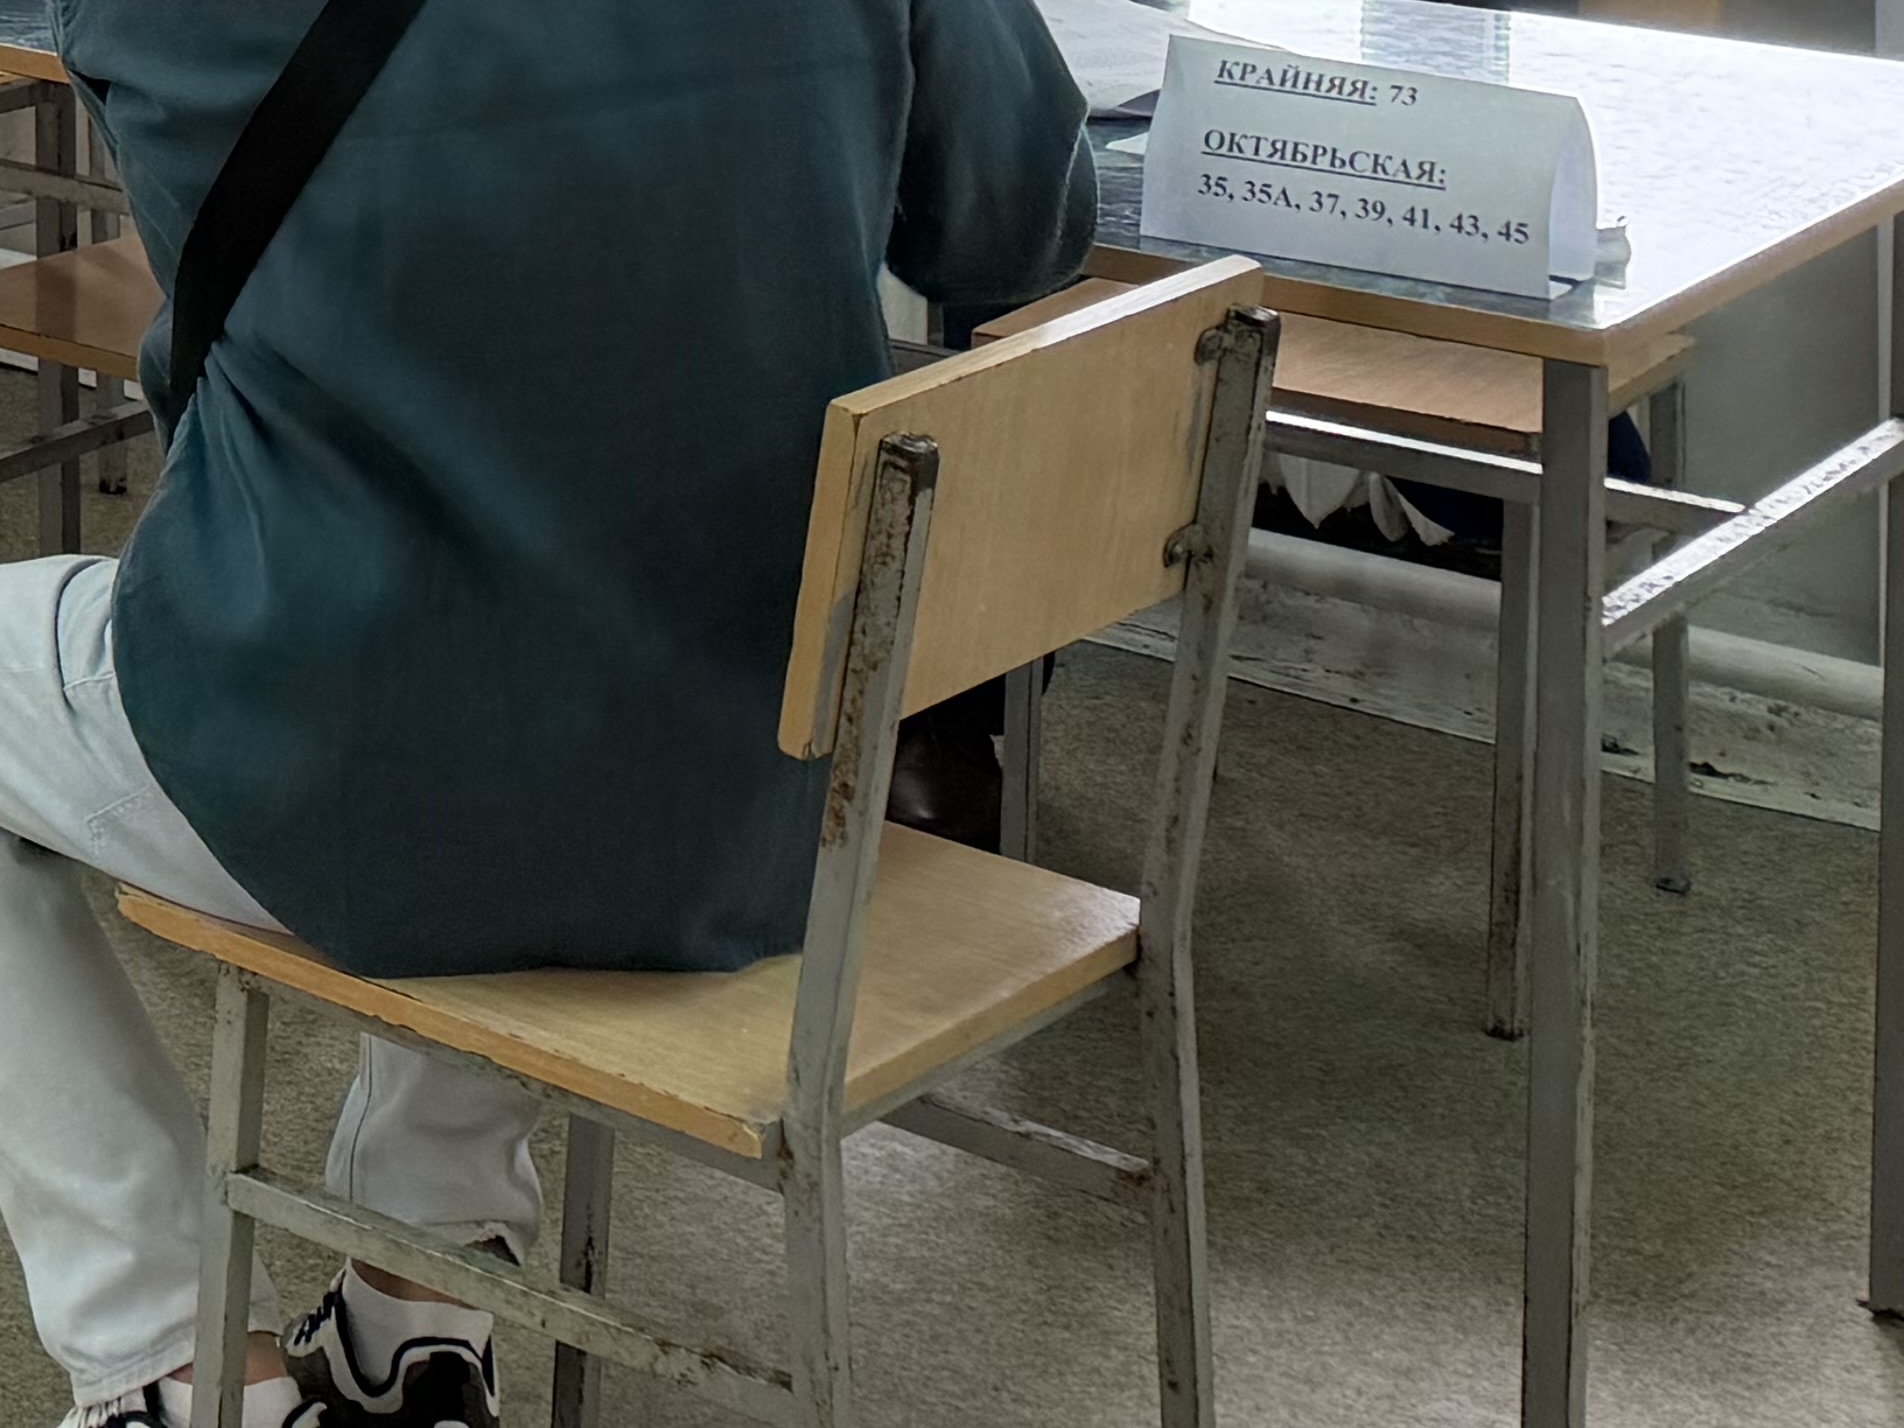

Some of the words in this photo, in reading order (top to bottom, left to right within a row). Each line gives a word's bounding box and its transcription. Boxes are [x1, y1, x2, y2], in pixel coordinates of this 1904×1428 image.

[1216, 59, 1378, 101] КРАЙНЯЯ:
[1389, 84, 1418, 107] 73
[1204, 129, 1446, 184] ОКТЯБРЬСКАЯ:
[1197, 173, 1235, 202] 35,
[1242, 180, 1301, 213] 35А,
[1309, 190, 1347, 220] 37,
[1354, 197, 1394, 228] 39,
[1402, 205, 1441, 233] 41,
[1449, 212, 1489, 243] 43,
[1497, 219, 1530, 245] 45
